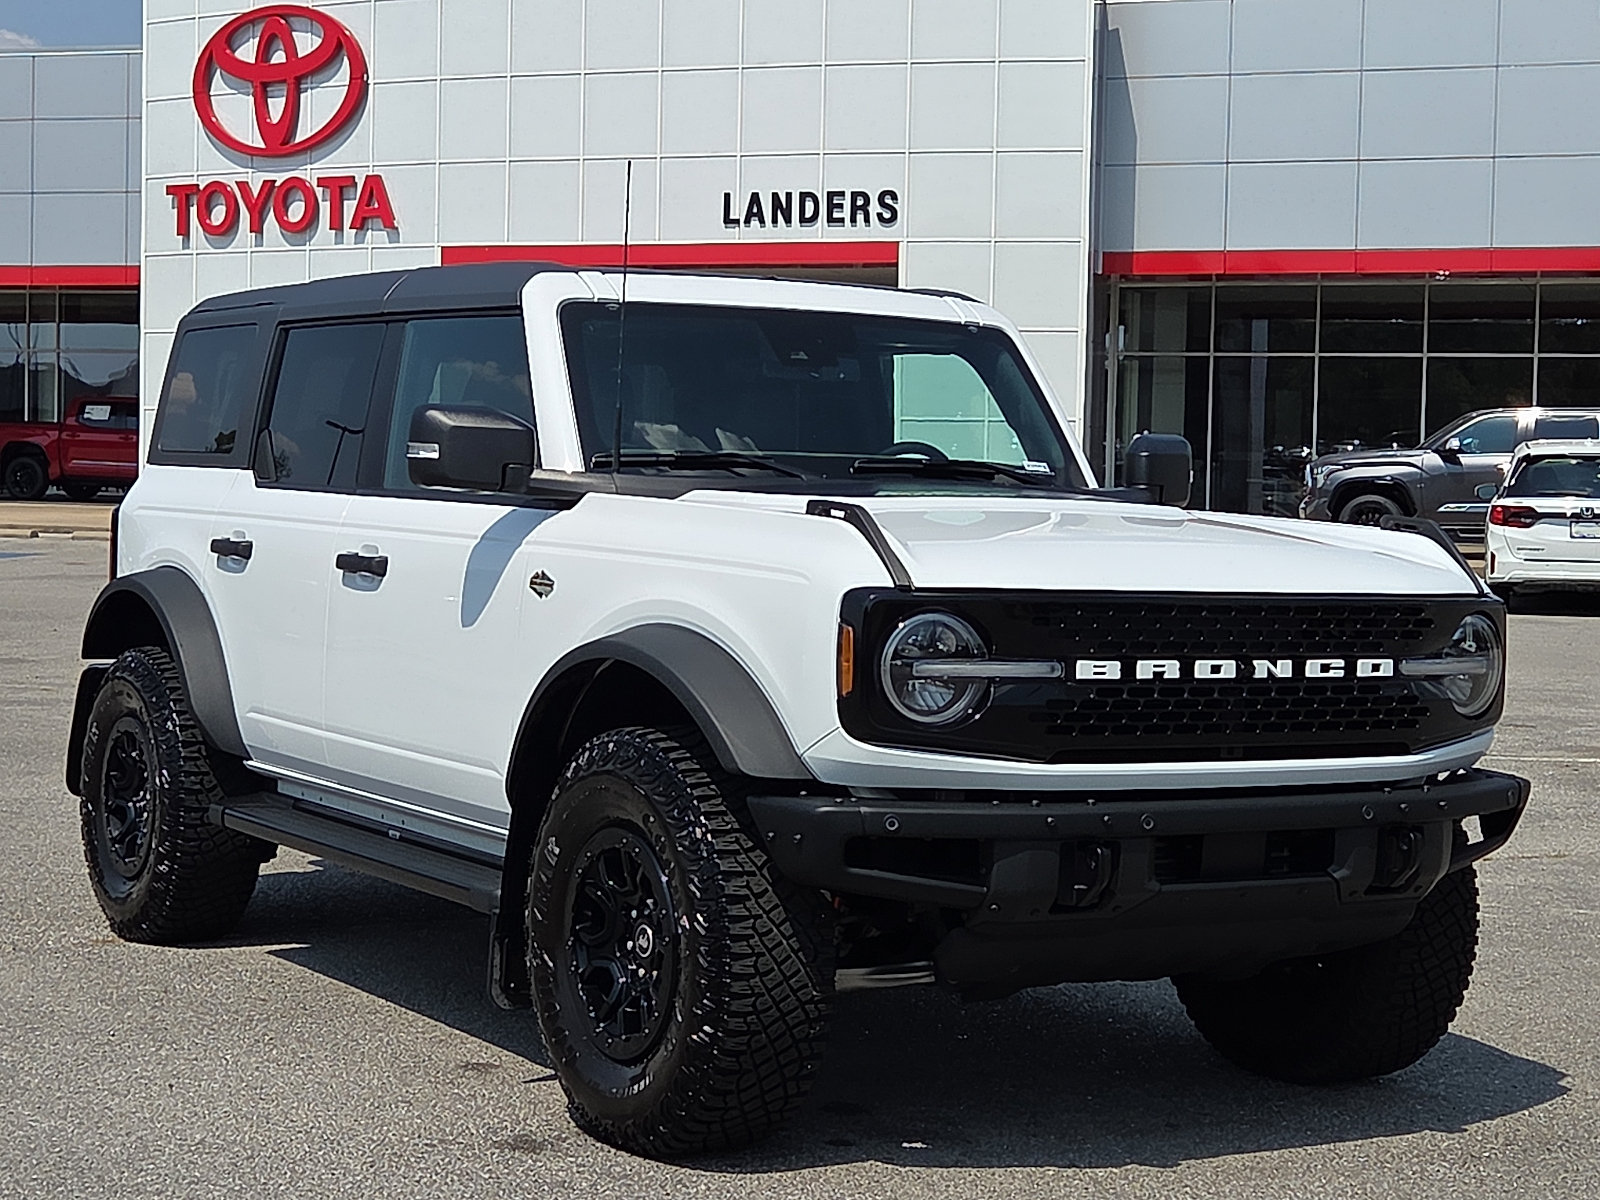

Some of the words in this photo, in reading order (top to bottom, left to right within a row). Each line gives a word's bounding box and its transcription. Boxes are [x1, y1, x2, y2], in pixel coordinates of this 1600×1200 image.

[166, 175, 397, 236] TOYOTA
[723, 190, 898, 226] LANDERS
[1076, 659, 1394, 679] BRONCO
